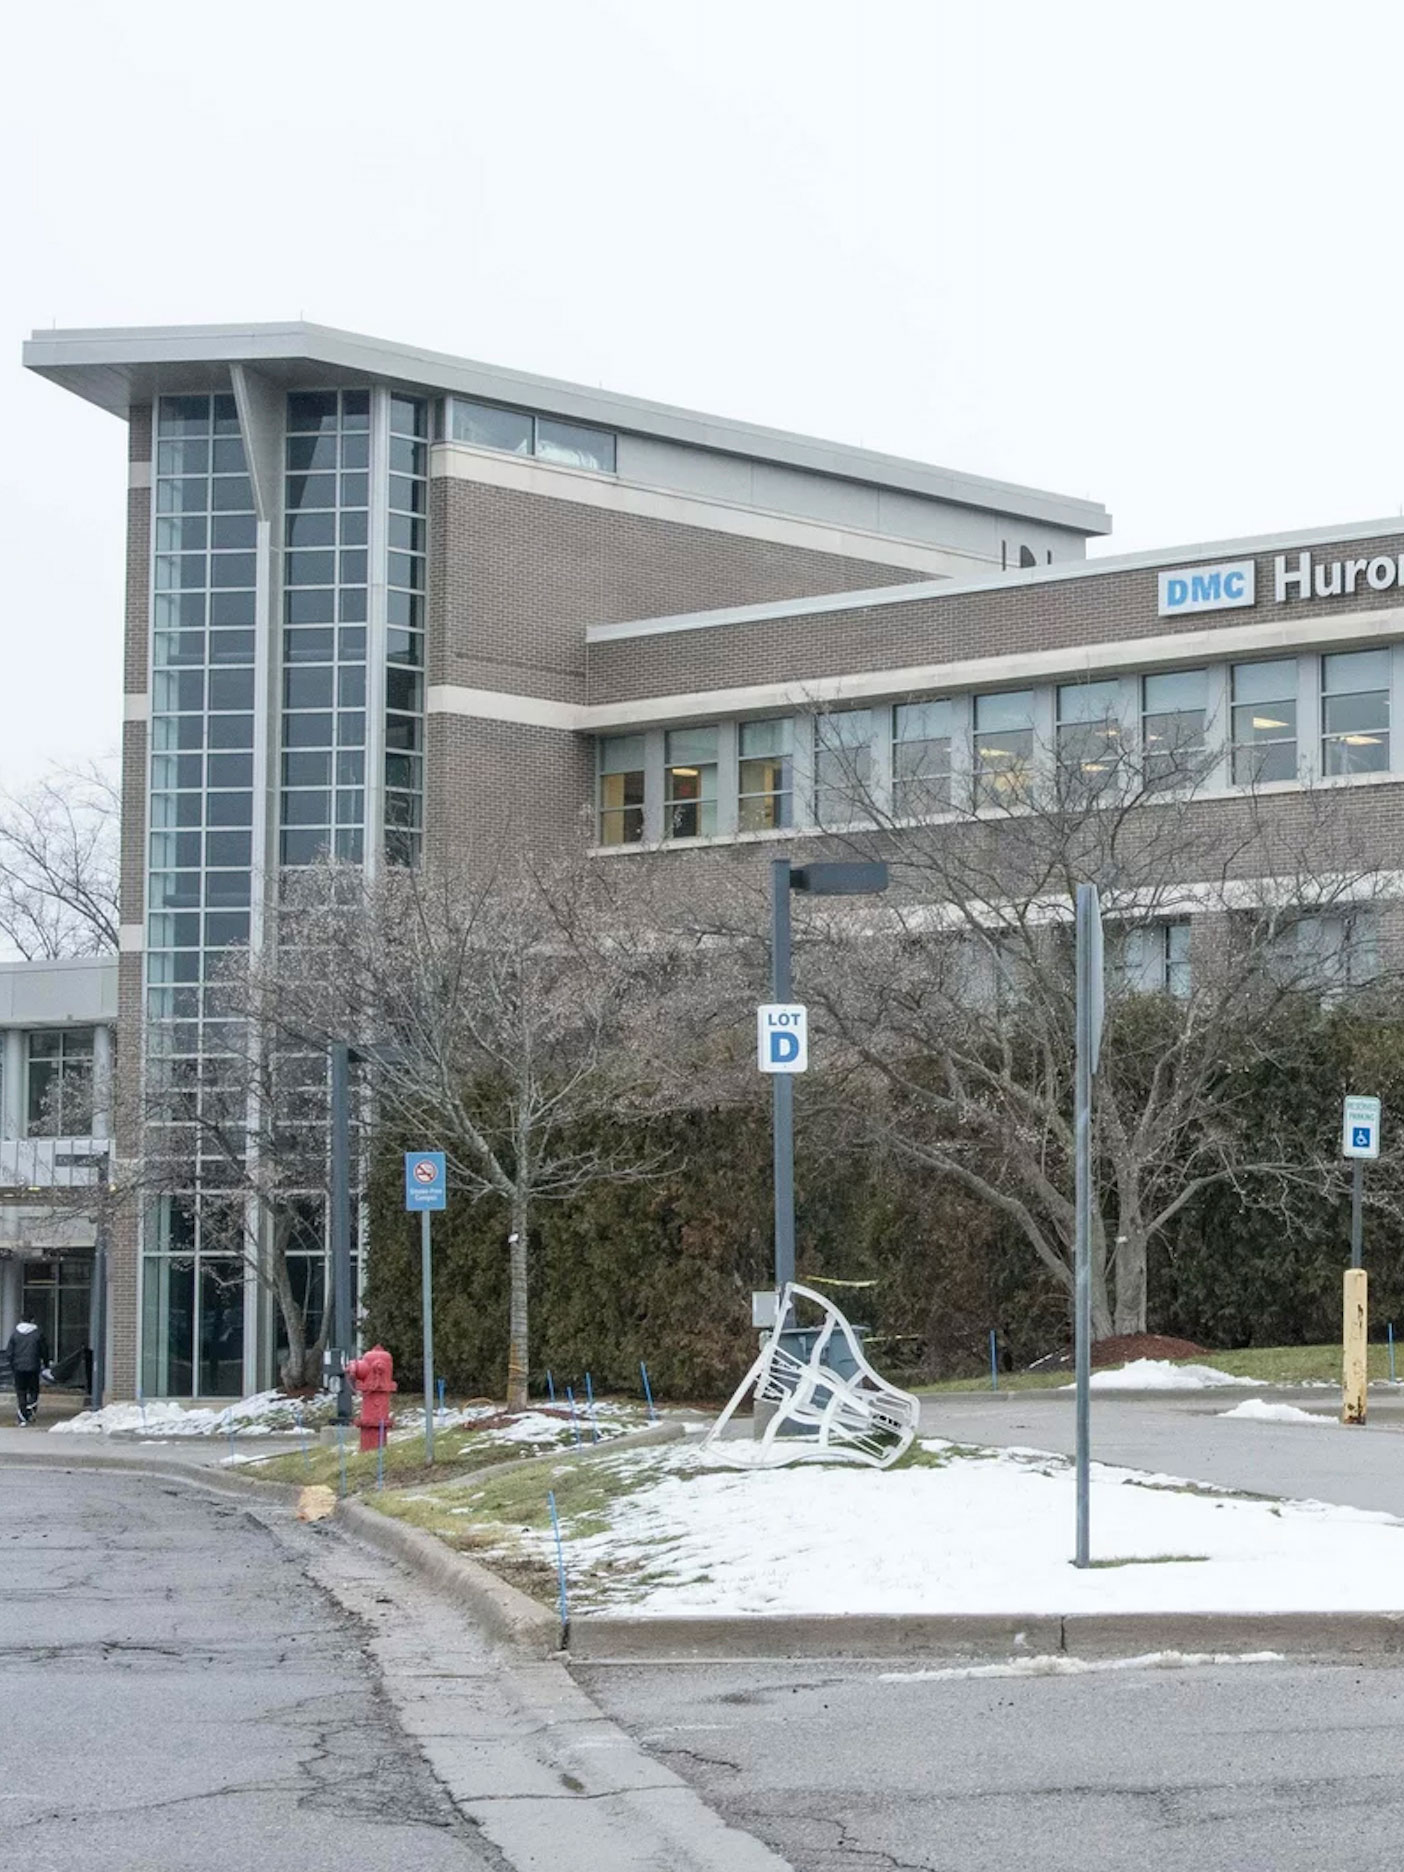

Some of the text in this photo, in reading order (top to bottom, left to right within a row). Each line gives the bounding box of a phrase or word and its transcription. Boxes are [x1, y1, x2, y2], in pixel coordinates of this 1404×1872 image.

[1167, 571, 1245, 607] DMC
[768, 1013, 801, 1026] LOT
[770, 1031, 799, 1062] D
